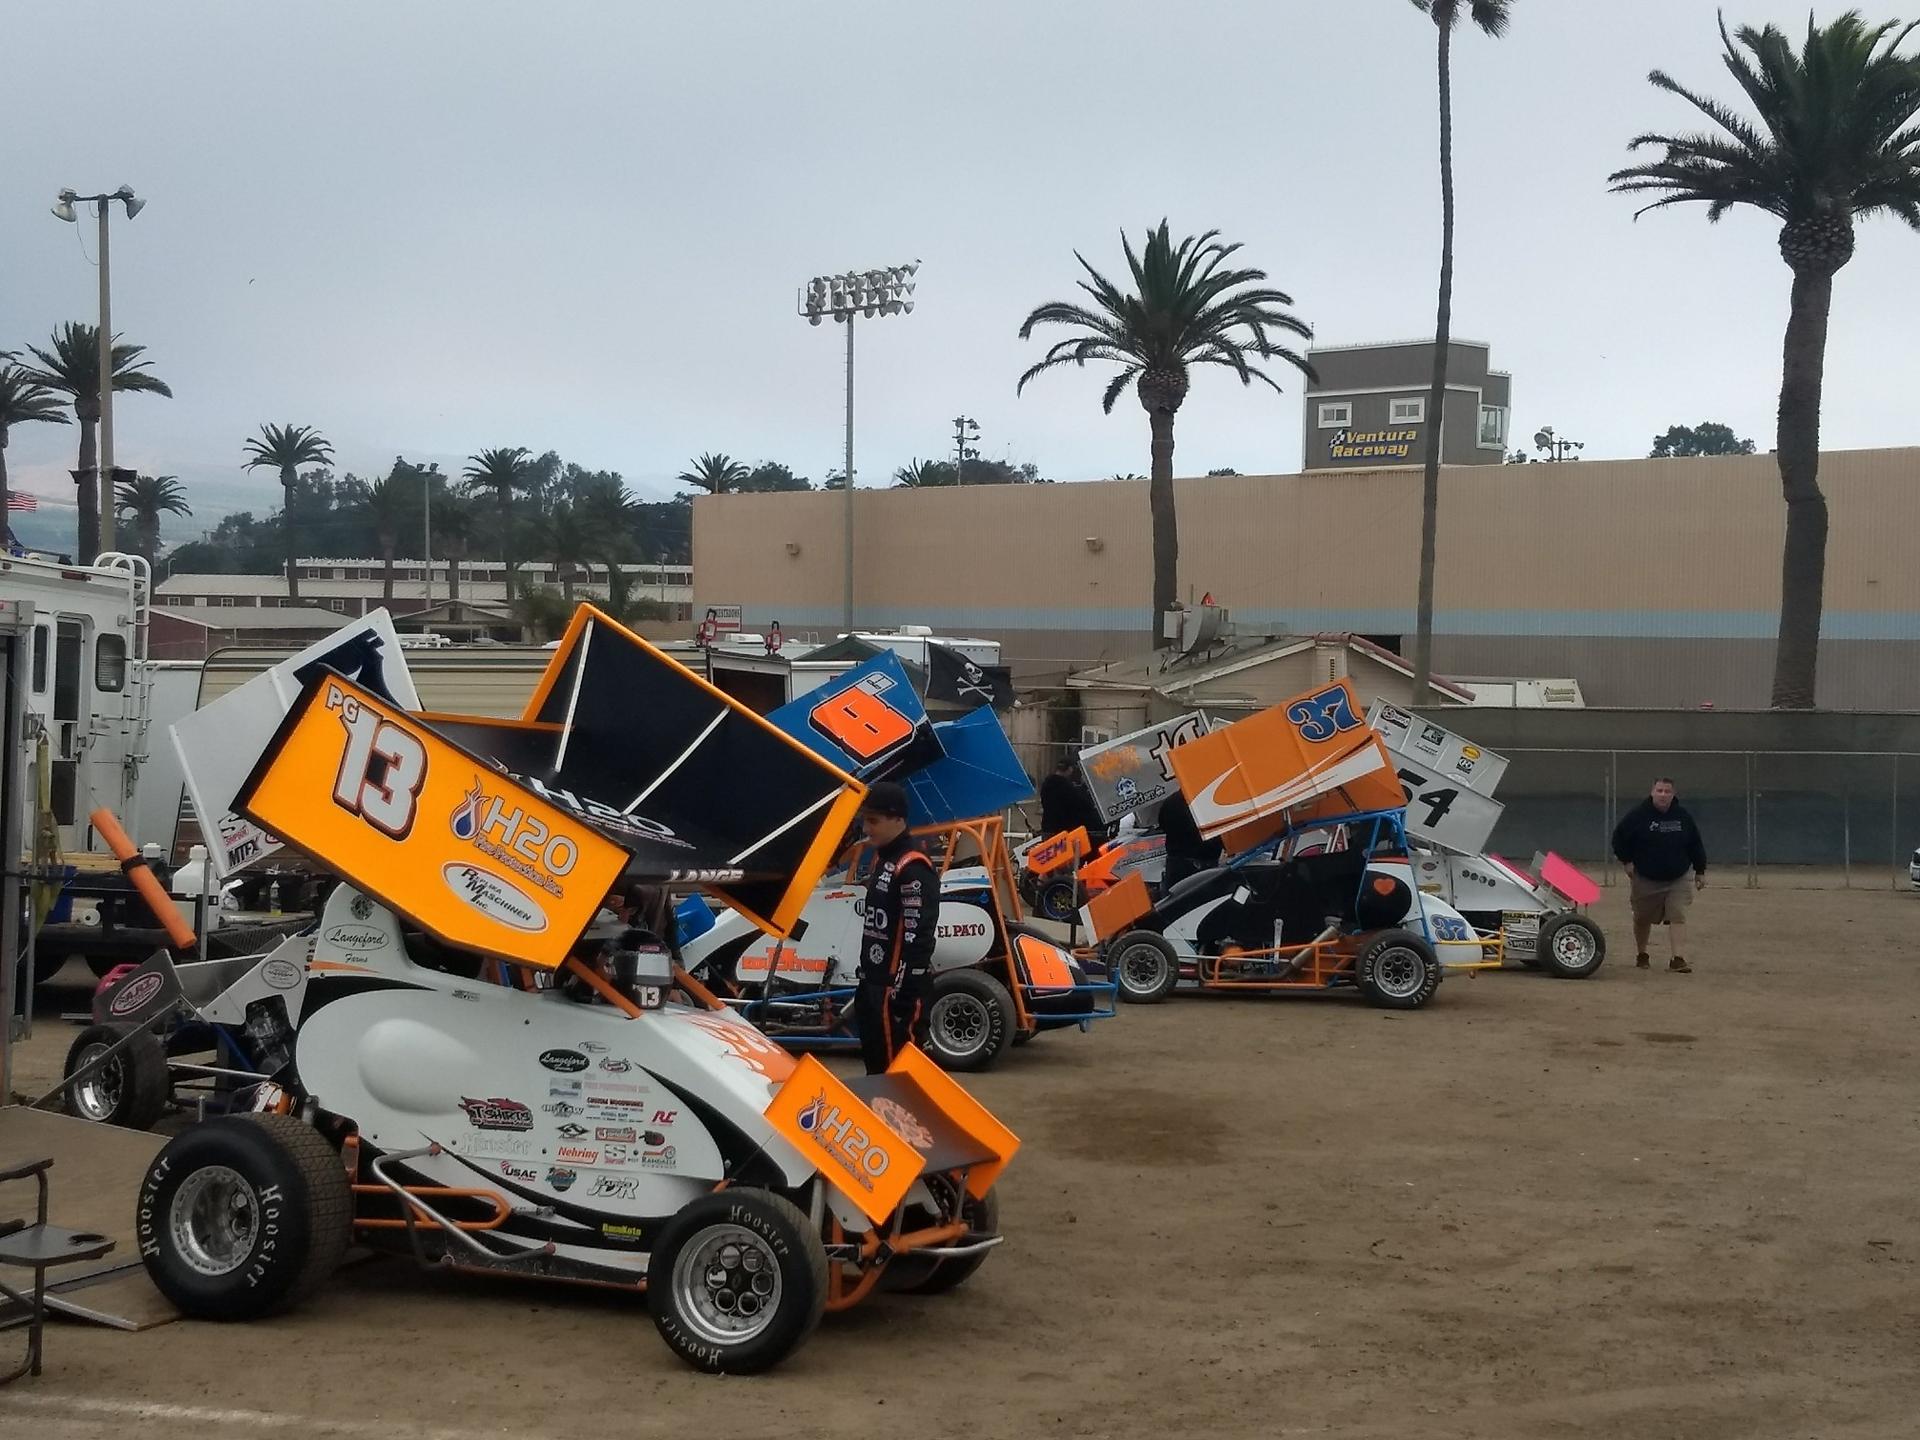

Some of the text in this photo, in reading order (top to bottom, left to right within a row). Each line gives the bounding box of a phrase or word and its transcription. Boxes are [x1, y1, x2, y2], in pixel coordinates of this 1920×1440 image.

[1346, 430, 1417, 444] Ventura
[1332, 444, 1409, 458] Raceway
[324, 682, 360, 724] PG
[1286, 683, 1365, 743] 37
[331, 702, 429, 843] 13
[482, 795, 579, 877] H2O
[465, 880, 532, 921] MASCHINEN
[330, 928, 385, 947] Langeford
[937, 923, 985, 938] EL PATO
[1430, 913, 1471, 941] 37
[641, 986, 660, 1007] 13
[558, 1145, 599, 1161] Nehring
[820, 1106, 890, 1177] H2O
[505, 1167, 537, 1179] USAC
